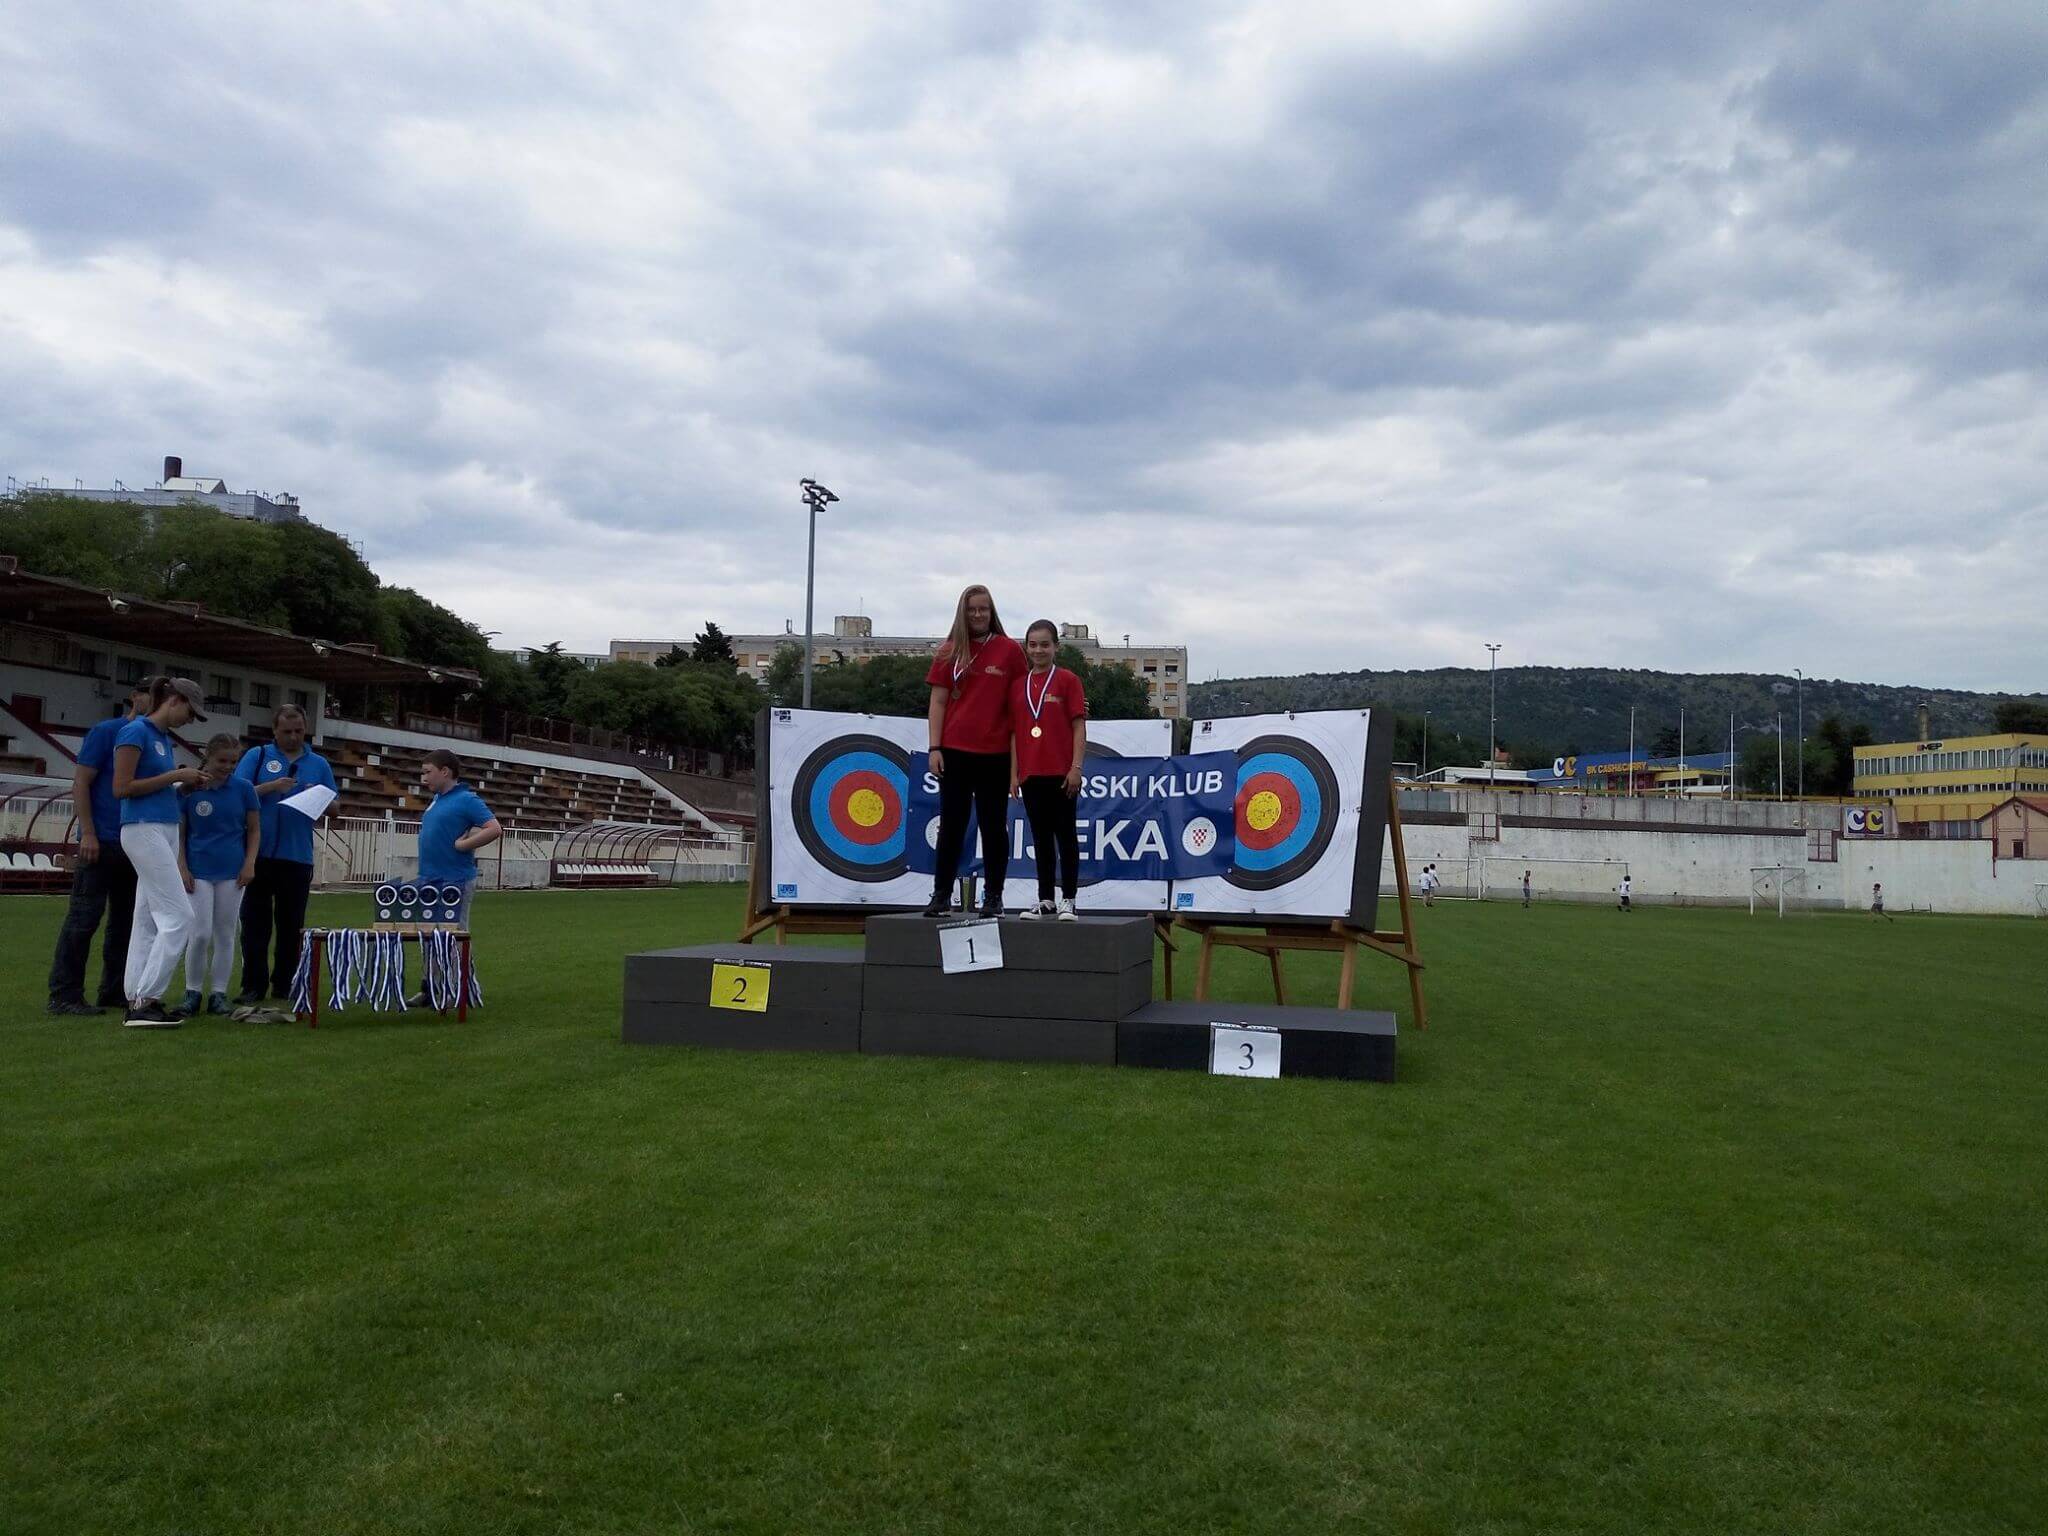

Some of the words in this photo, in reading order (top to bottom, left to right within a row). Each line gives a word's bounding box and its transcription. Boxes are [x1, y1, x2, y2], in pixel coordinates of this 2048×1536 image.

[1148, 770, 1223, 798] KLUB
[967, 937, 978, 964] 1
[731, 977, 748, 1003] 2
[1238, 1043, 1254, 1070] 3
